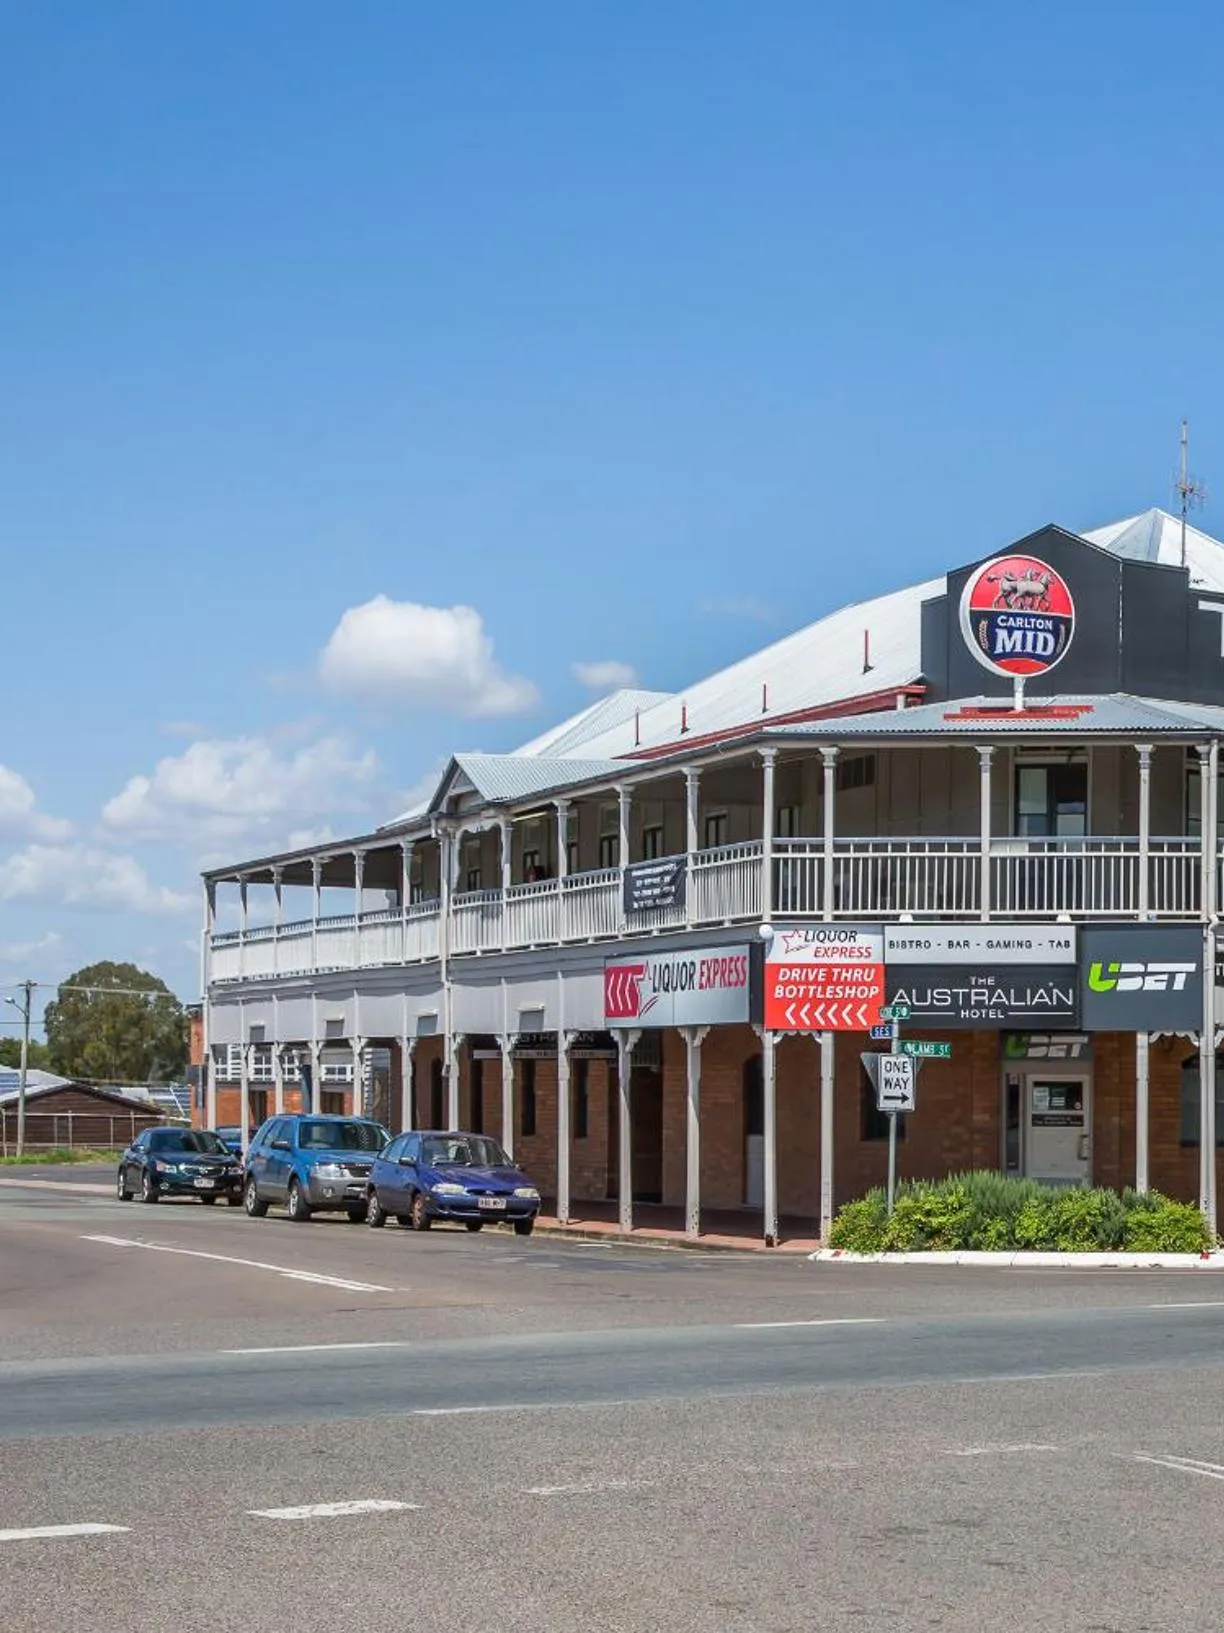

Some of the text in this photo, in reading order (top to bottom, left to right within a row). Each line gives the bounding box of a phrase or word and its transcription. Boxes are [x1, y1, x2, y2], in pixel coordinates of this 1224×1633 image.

[997, 615, 1053, 630] CARLTON
[994, 628, 1055, 656] MID
[804, 930, 857, 944] LIQUOR
[889, 940, 932, 949] BISTRO
[948, 940, 970, 949] BAR
[986, 940, 1032, 949] GAMING
[1048, 940, 1071, 949] TAB
[813, 946, 872, 959] EXPRESS
[652, 956, 747, 993] LIQUOR EXPRESS
[778, 968, 875, 982] DRIVE THRU
[970, 976, 995, 985] THE
[1088, 962, 1196, 992] UBET
[774, 985, 880, 999] BOTTLESHOP
[891, 989, 1073, 1006] AUSTRALIAN
[961, 1009, 1004, 1018] HOTEL
[874, 1027, 890, 1036] SES
[884, 1061, 908, 1073] ONE
[884, 1078, 909, 1090] WAY
